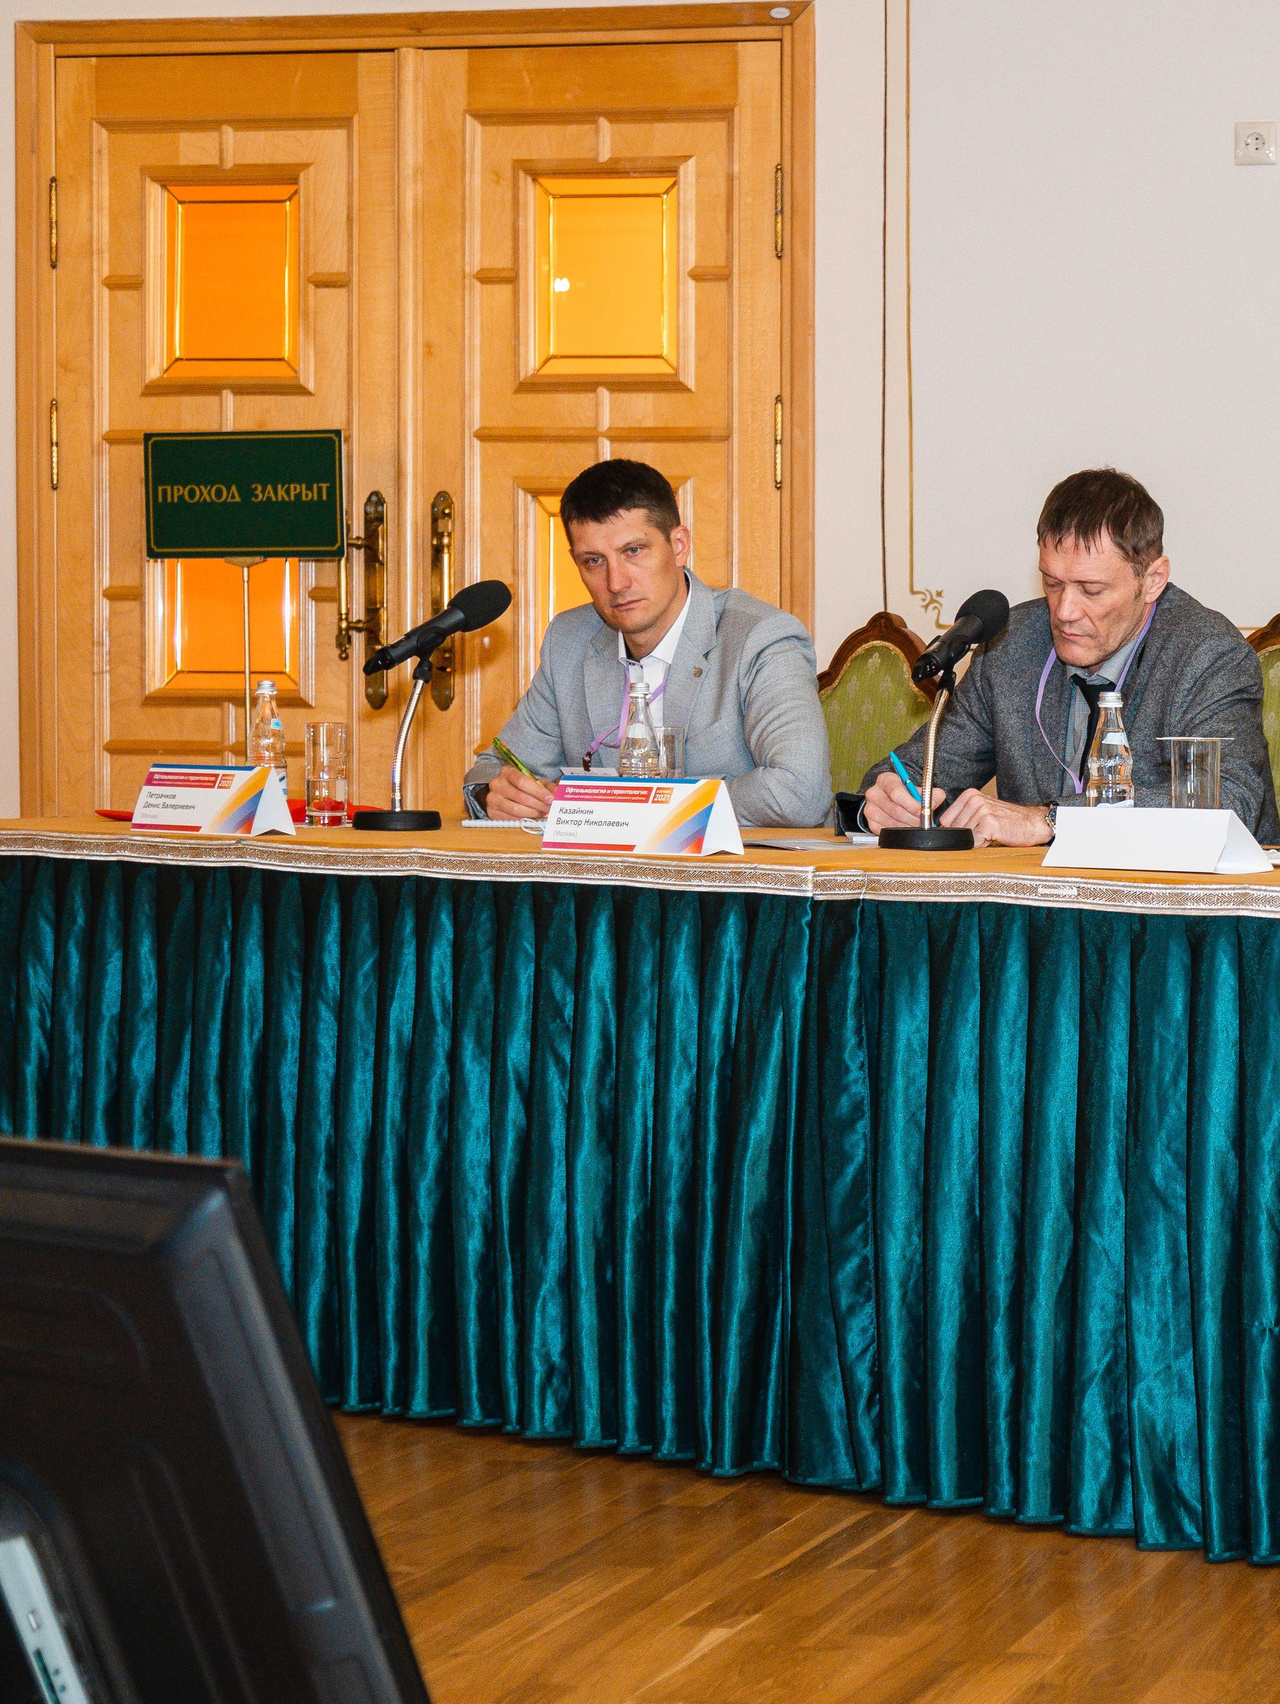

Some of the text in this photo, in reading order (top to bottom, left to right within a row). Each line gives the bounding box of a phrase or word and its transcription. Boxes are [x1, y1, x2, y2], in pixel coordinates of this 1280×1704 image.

[157, 482, 330, 503] ПРОХОД ЗАКРЫТ
[146, 791, 177, 799] Петрачков
[142, 801, 161, 809] Денис
[559, 807, 594, 815] Казайкин
[556, 817, 629, 827] Виктор Николаевич
